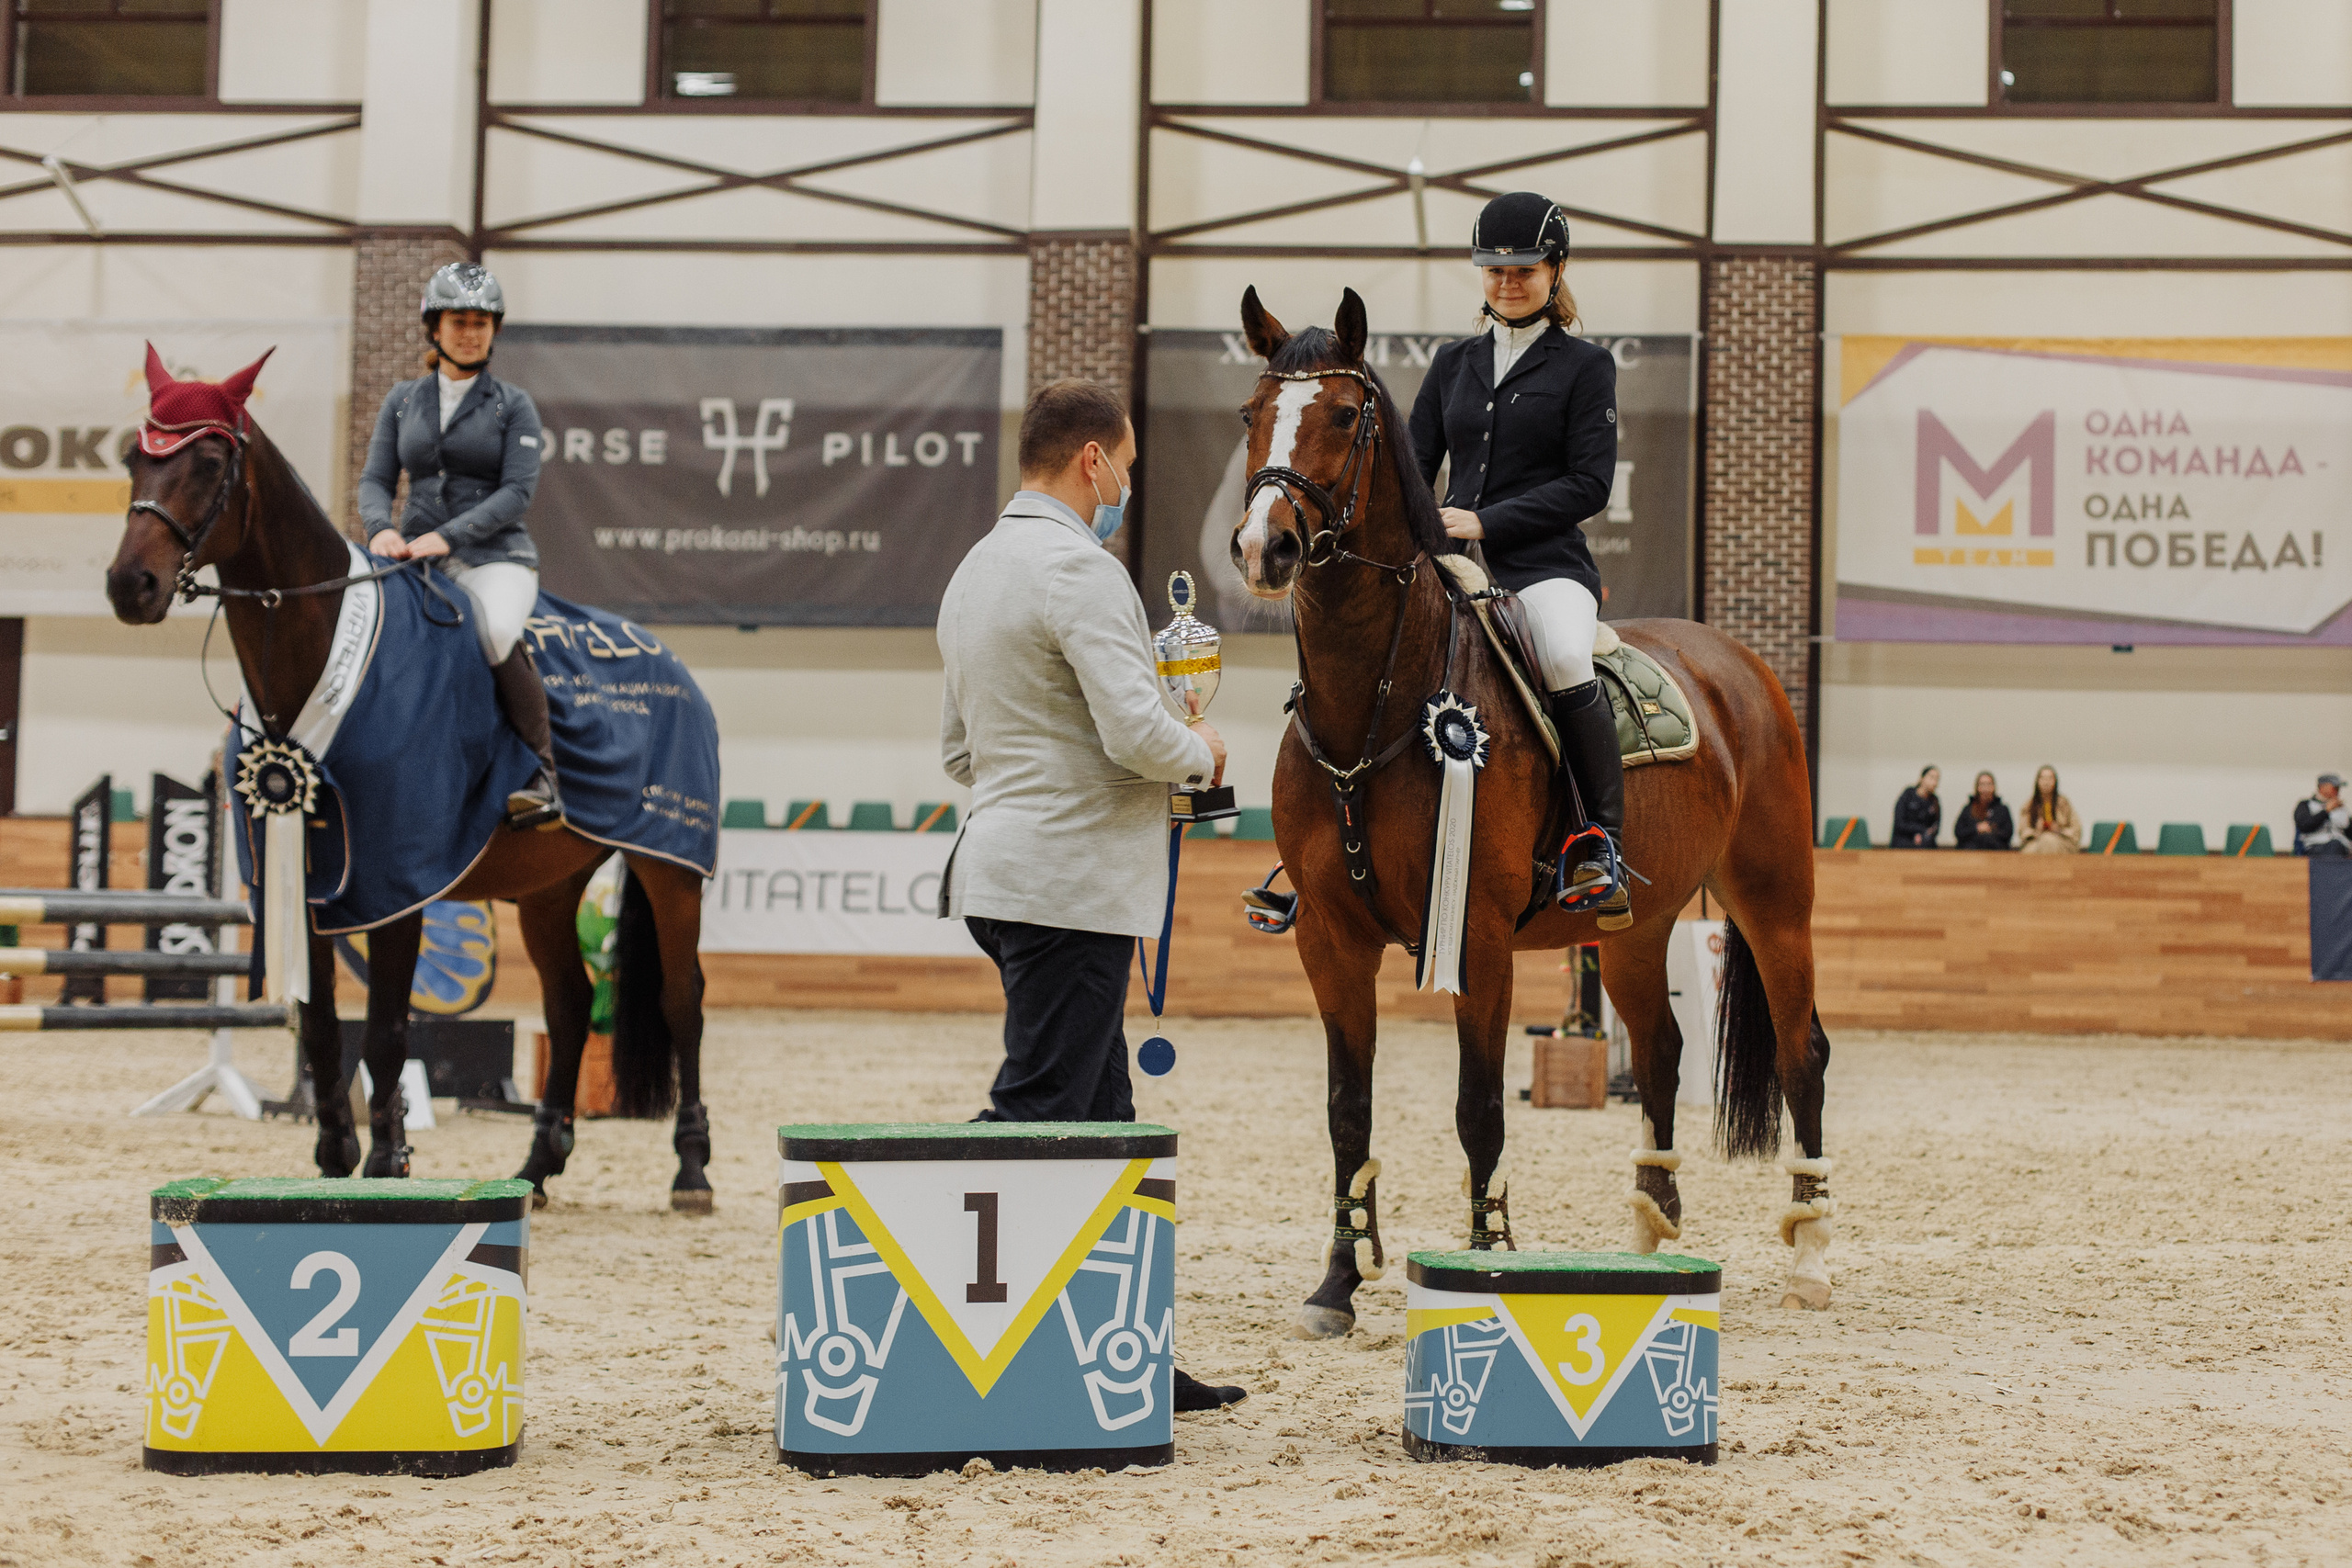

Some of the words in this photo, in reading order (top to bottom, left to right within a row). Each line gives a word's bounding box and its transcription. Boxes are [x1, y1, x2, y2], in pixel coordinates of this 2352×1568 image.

[2085, 410, 2192, 438] ОДНА
[823, 431, 983, 468] PILOT
[2086, 445, 2306, 479] КОМАНДА
[2085, 493, 2191, 523] ОДНА
[2086, 530, 2324, 572] ПОБЕДА!
[1449, 818, 1457, 838] 2020
[1445, 839, 1455, 875] VITATELOS
[965, 1192, 1009, 1303] 1
[288, 1250, 361, 1359] 2
[1558, 1313, 1605, 1386] 3
